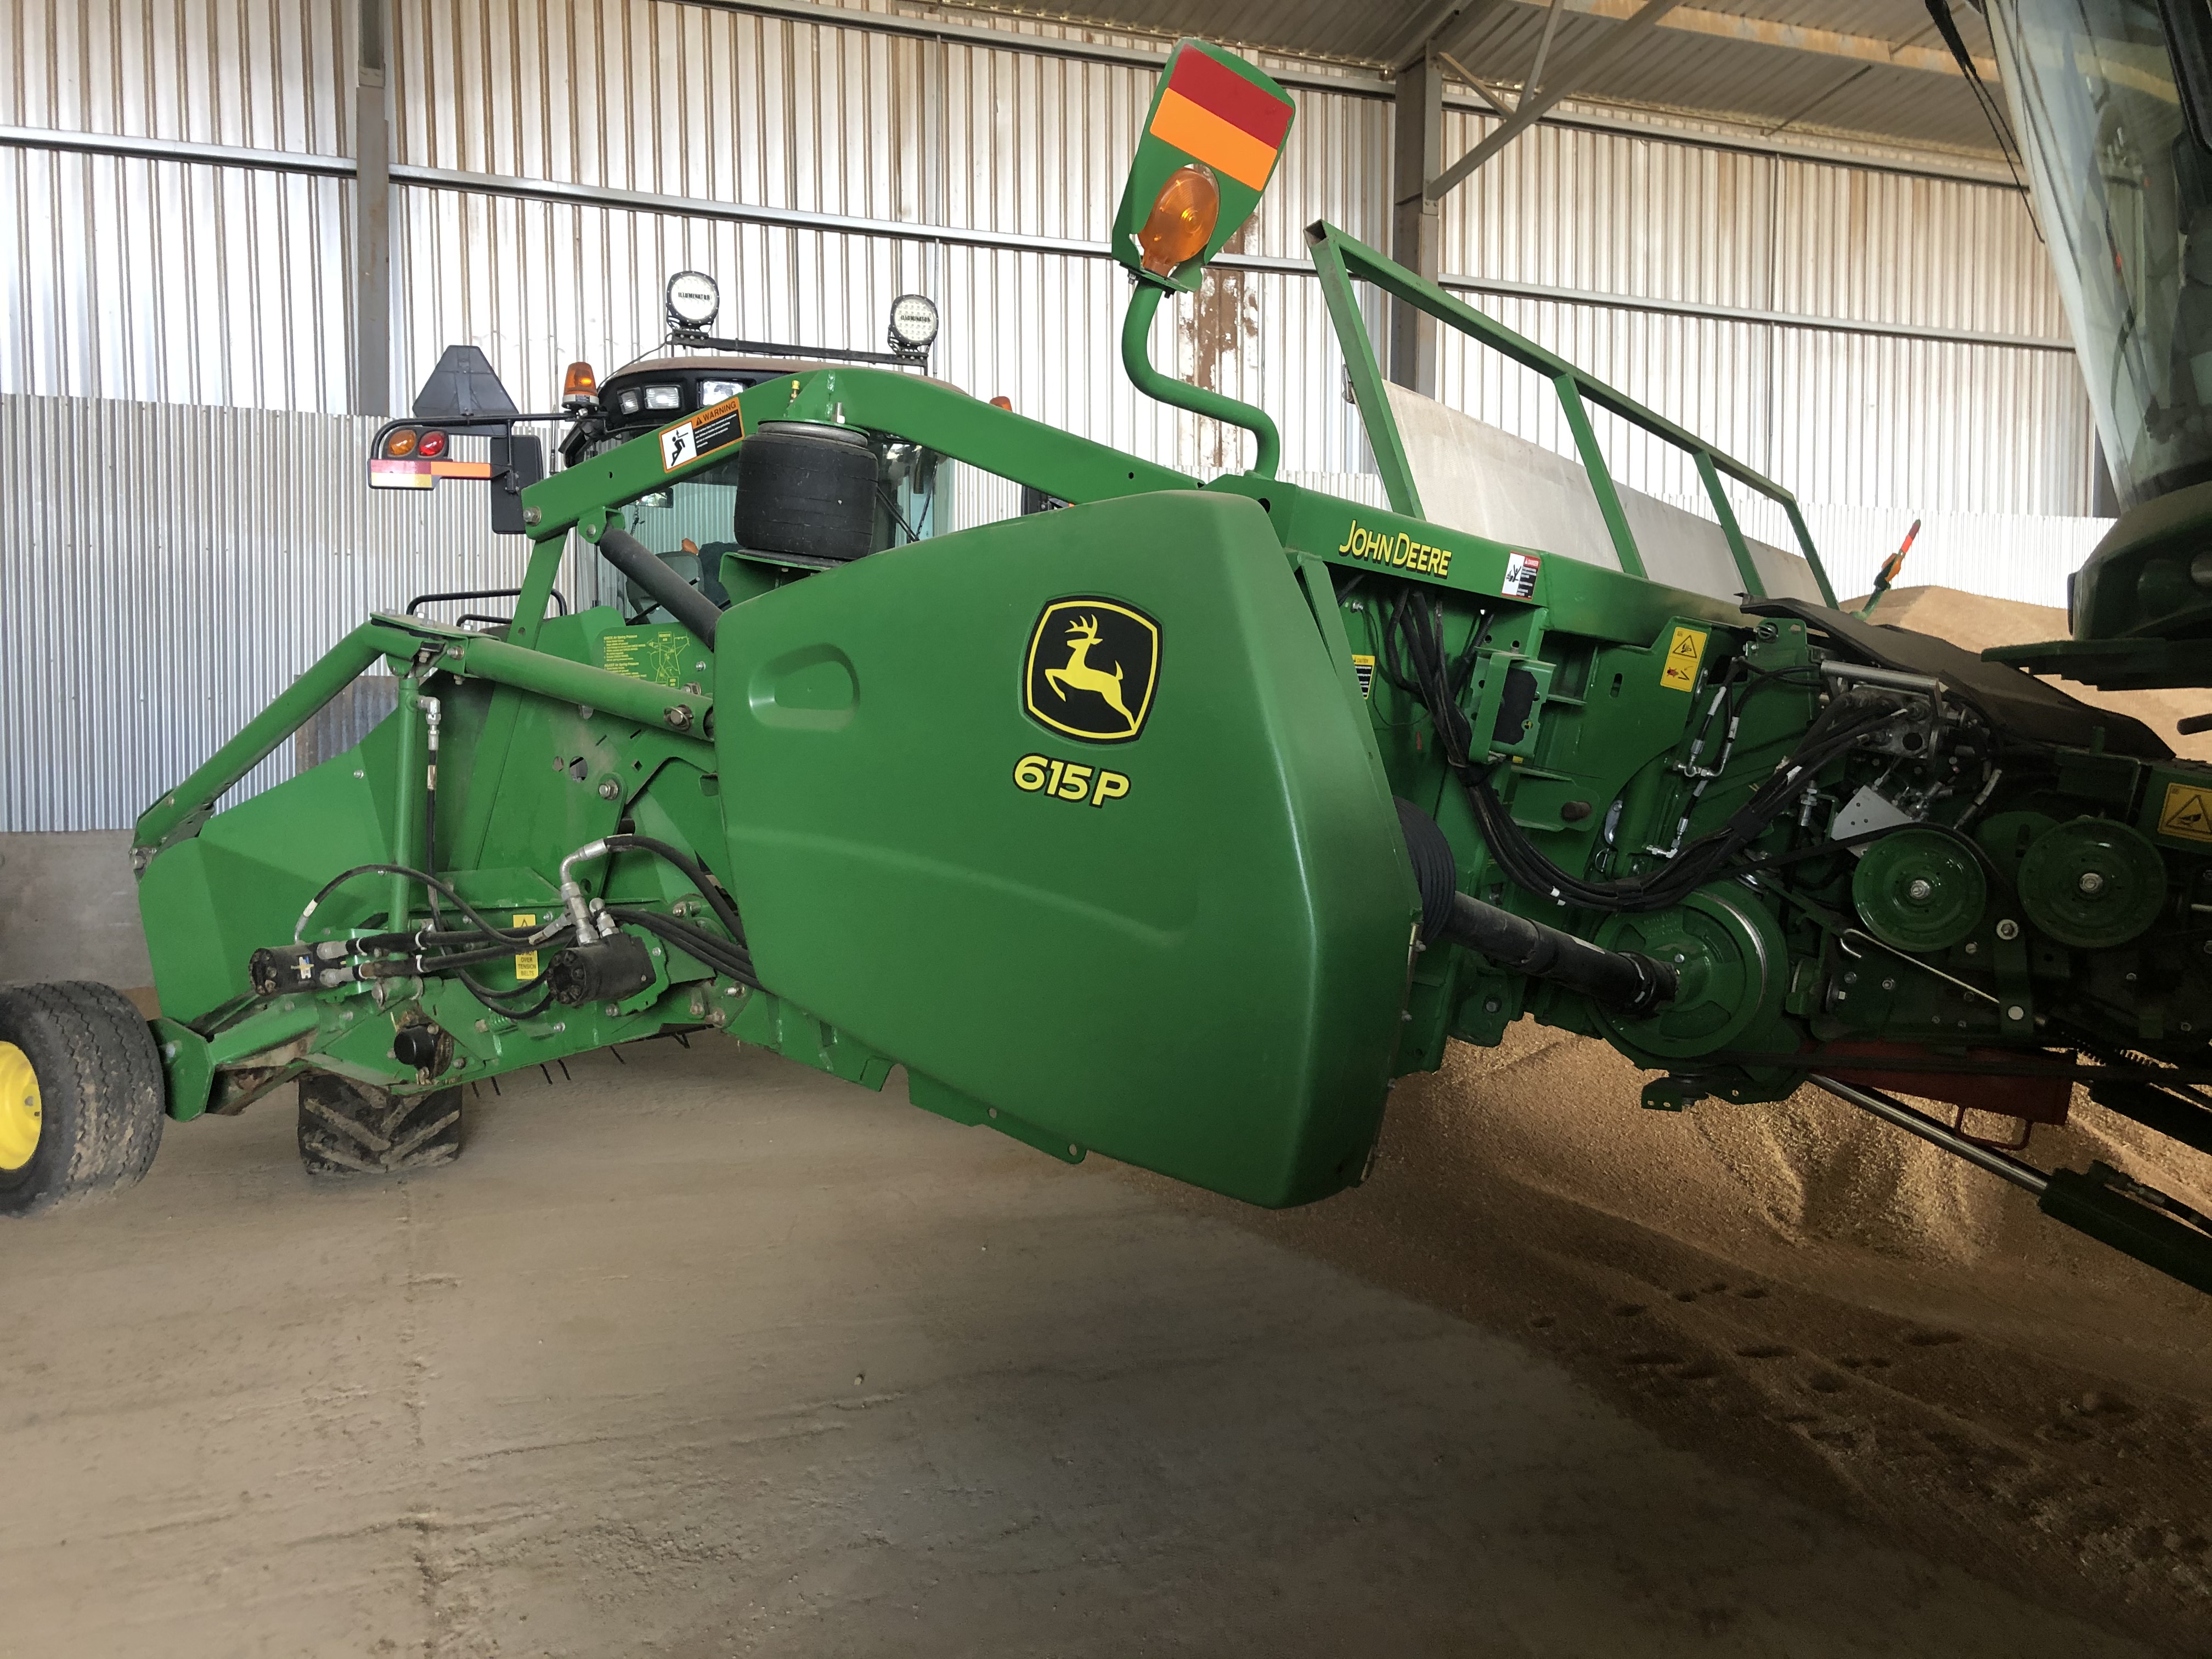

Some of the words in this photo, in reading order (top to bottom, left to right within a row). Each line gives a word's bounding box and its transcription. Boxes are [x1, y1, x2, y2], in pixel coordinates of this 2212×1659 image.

[703, 401, 736, 421] WARNING
[1339, 519, 1394, 564] JOHN
[1392, 532, 1452, 579] DEERE
[1013, 752, 1131, 809] 615P
